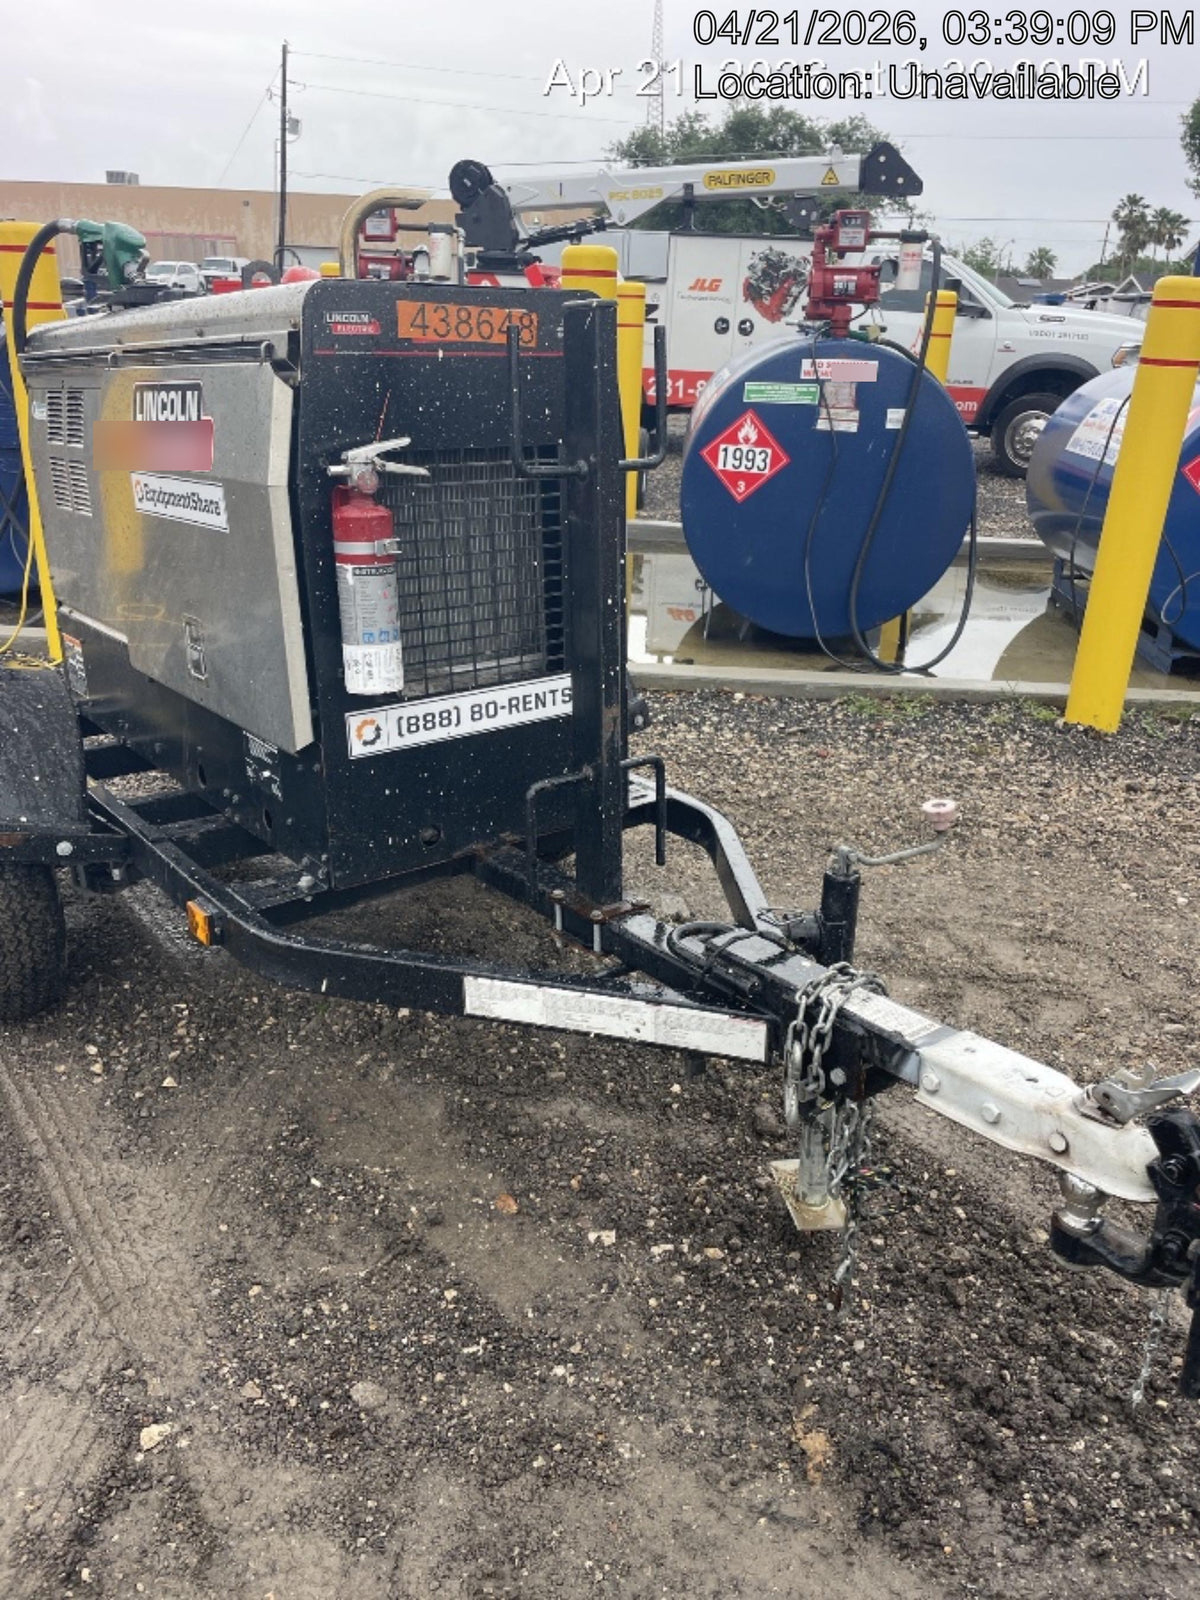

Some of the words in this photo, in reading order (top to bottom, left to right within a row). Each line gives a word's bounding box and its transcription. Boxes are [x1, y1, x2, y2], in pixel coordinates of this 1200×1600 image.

[708, 171, 771, 187] PALFINGER
[688, 278, 722, 292] JLG
[326, 312, 370, 323] LINCOLN
[410, 303, 534, 345] 438648
[136, 390, 199, 422] LINCOLN
[721, 446, 769, 472] 1993
[144, 482, 221, 516] EquipmentShare
[736, 481, 746, 494] 3
[397, 706, 460, 738] (888)
[470, 687, 572, 722] 80-RENTS
